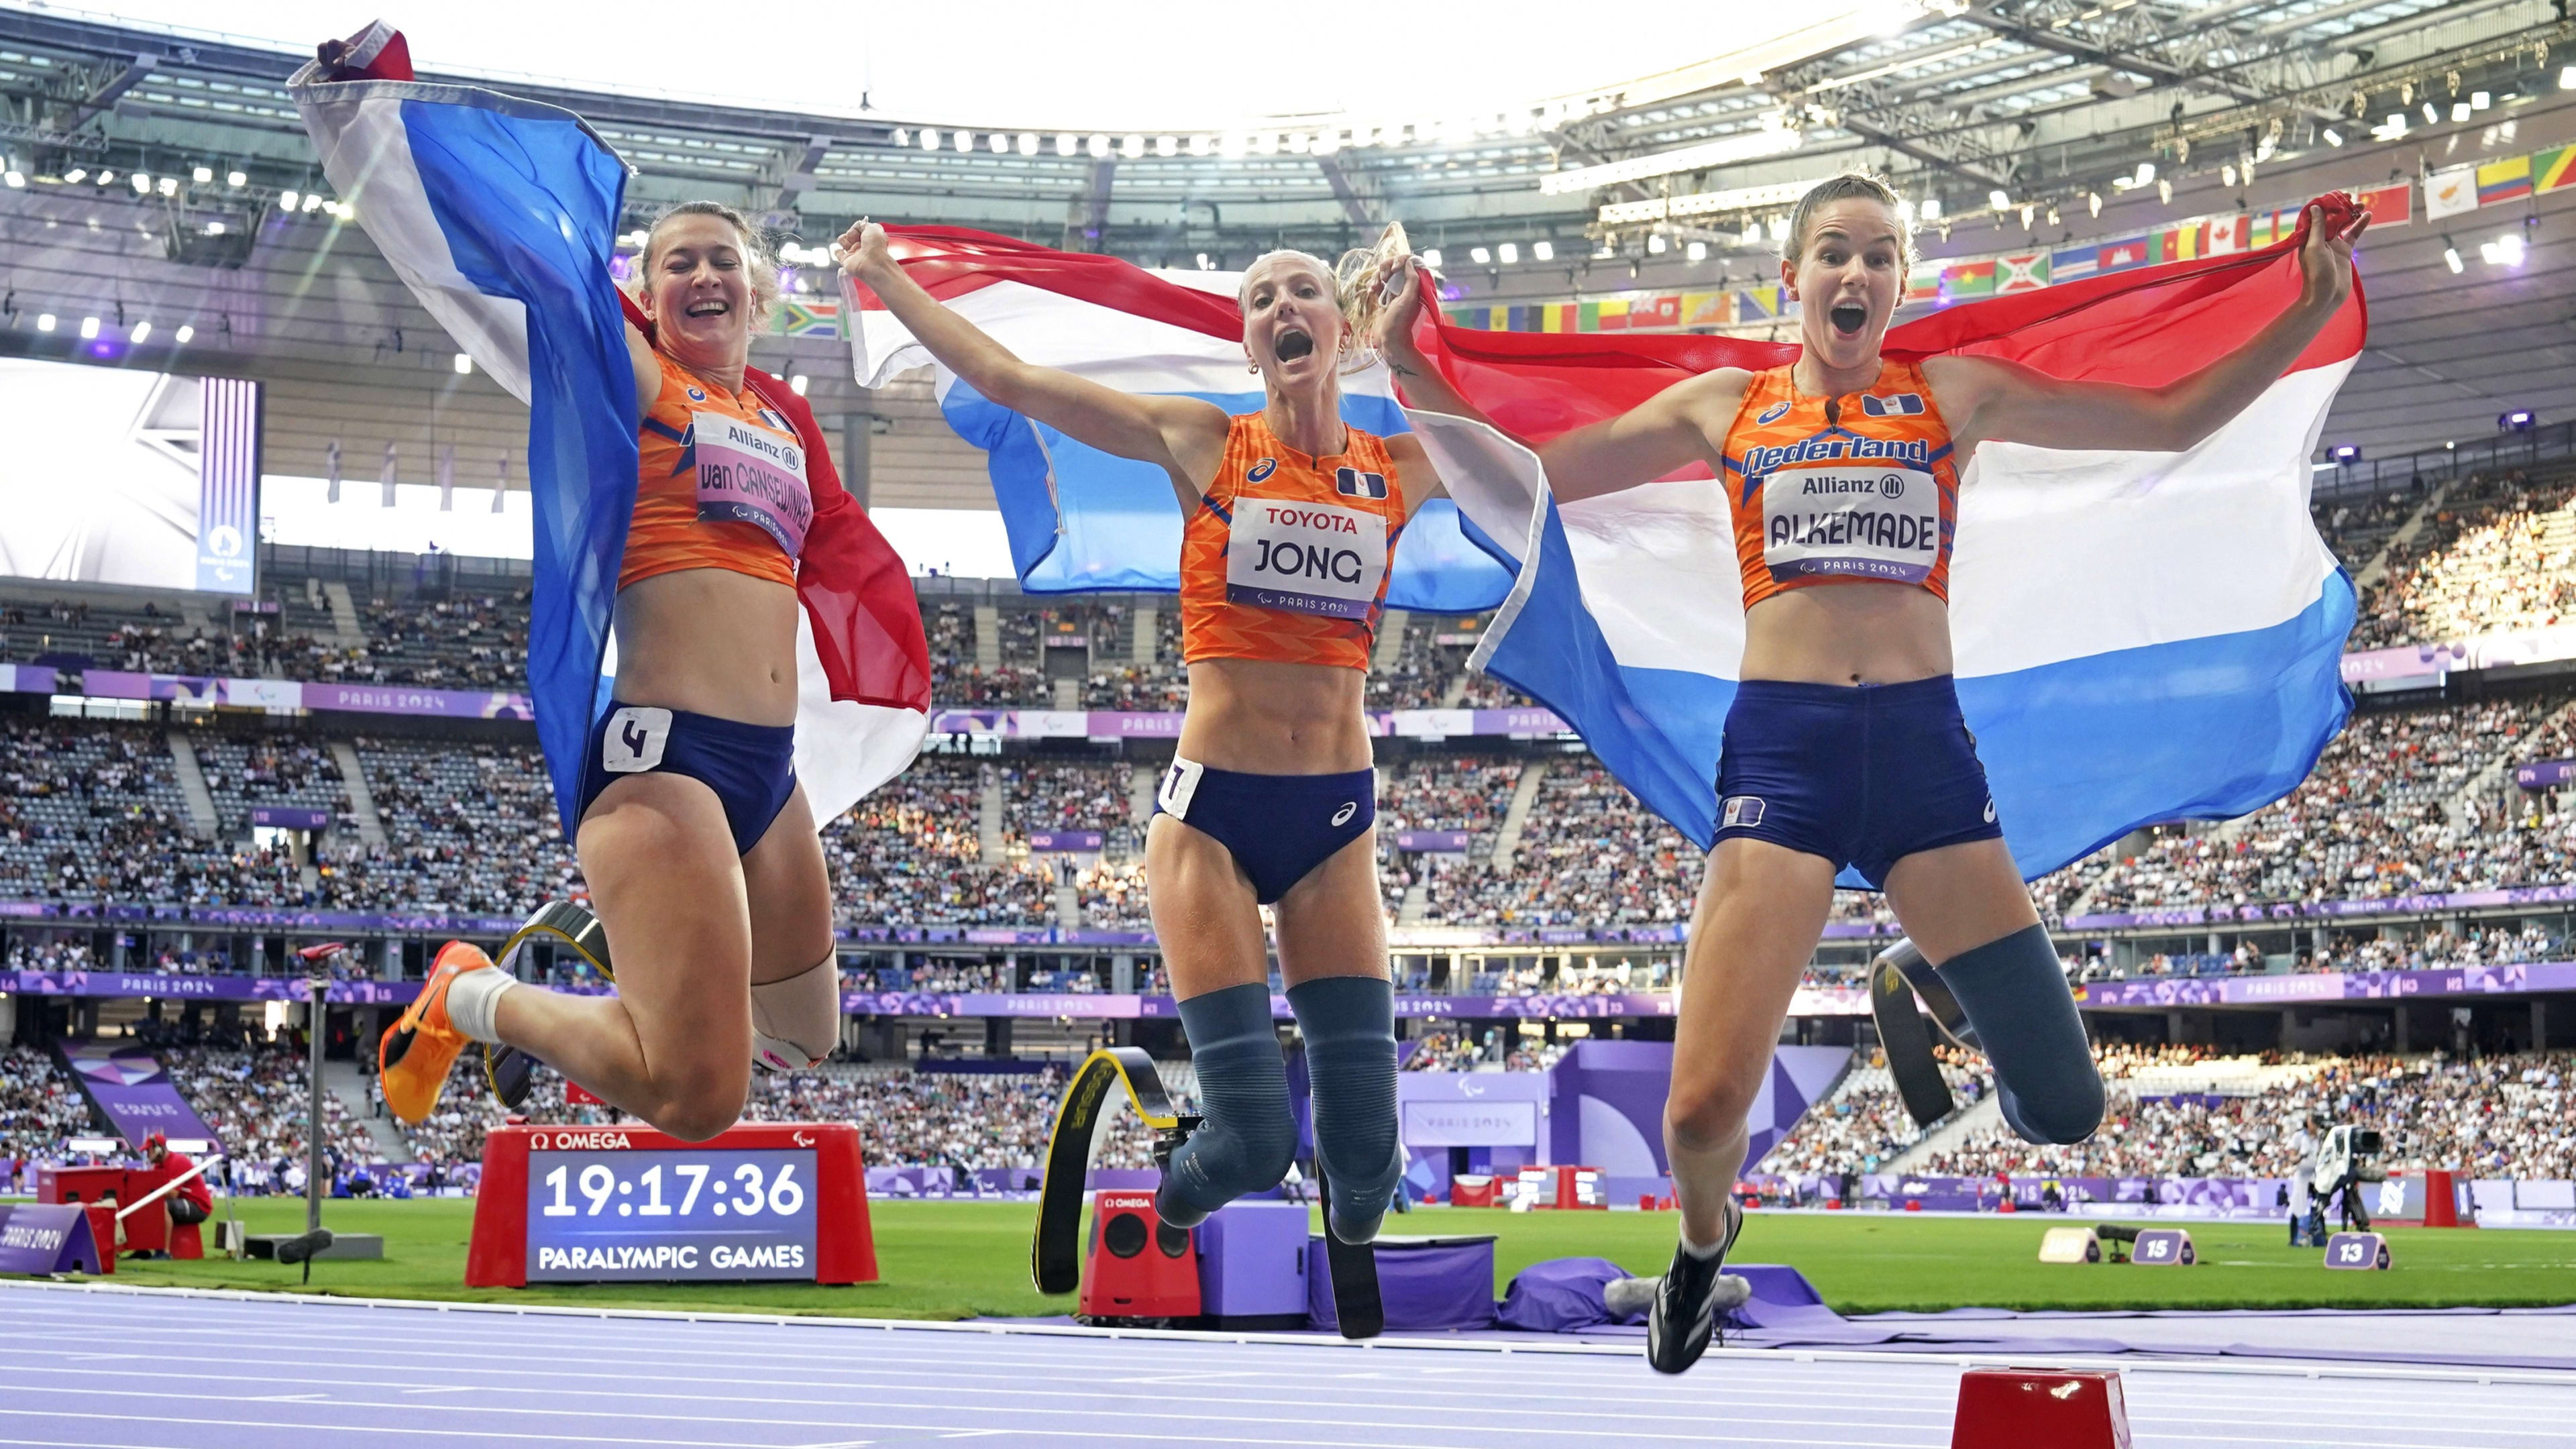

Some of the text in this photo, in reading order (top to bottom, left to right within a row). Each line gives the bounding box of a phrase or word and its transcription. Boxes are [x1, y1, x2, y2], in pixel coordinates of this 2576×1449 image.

[729, 426, 780, 459] Allianz
[701, 464, 733, 490] van
[1803, 476, 1874, 495] Allianz
[753, 511, 776, 531] PARIS
[1267, 508, 1358, 535] TOYOTA
[1771, 511, 1935, 551] ALKEMADE
[1254, 539, 1362, 584] JONG
[1823, 561, 1907, 576] PARIS 2024
[1279, 596, 1348, 612] PARIS 2024
[339, 690, 445, 709] PARIS 2024
[1122, 717, 1173, 732] PARIS
[622, 720, 648, 759] 4
[121, 978, 214, 994] PARIS 2024
[2247, 980, 2285, 996] PARIS
[1007, 999, 1050, 1011] PARIS
[1411, 1000, 1452, 1013] 2024
[555, 1132, 631, 1150] OMEGA
[543, 1164, 804, 1217] 19:17:36
[1115, 1197, 1151, 1208] OMEGA
[539, 1245, 804, 1269] PARALYMPIC GAMES
[2147, 1240, 2168, 1258] 15
[2340, 1243, 2363, 1263] 13
